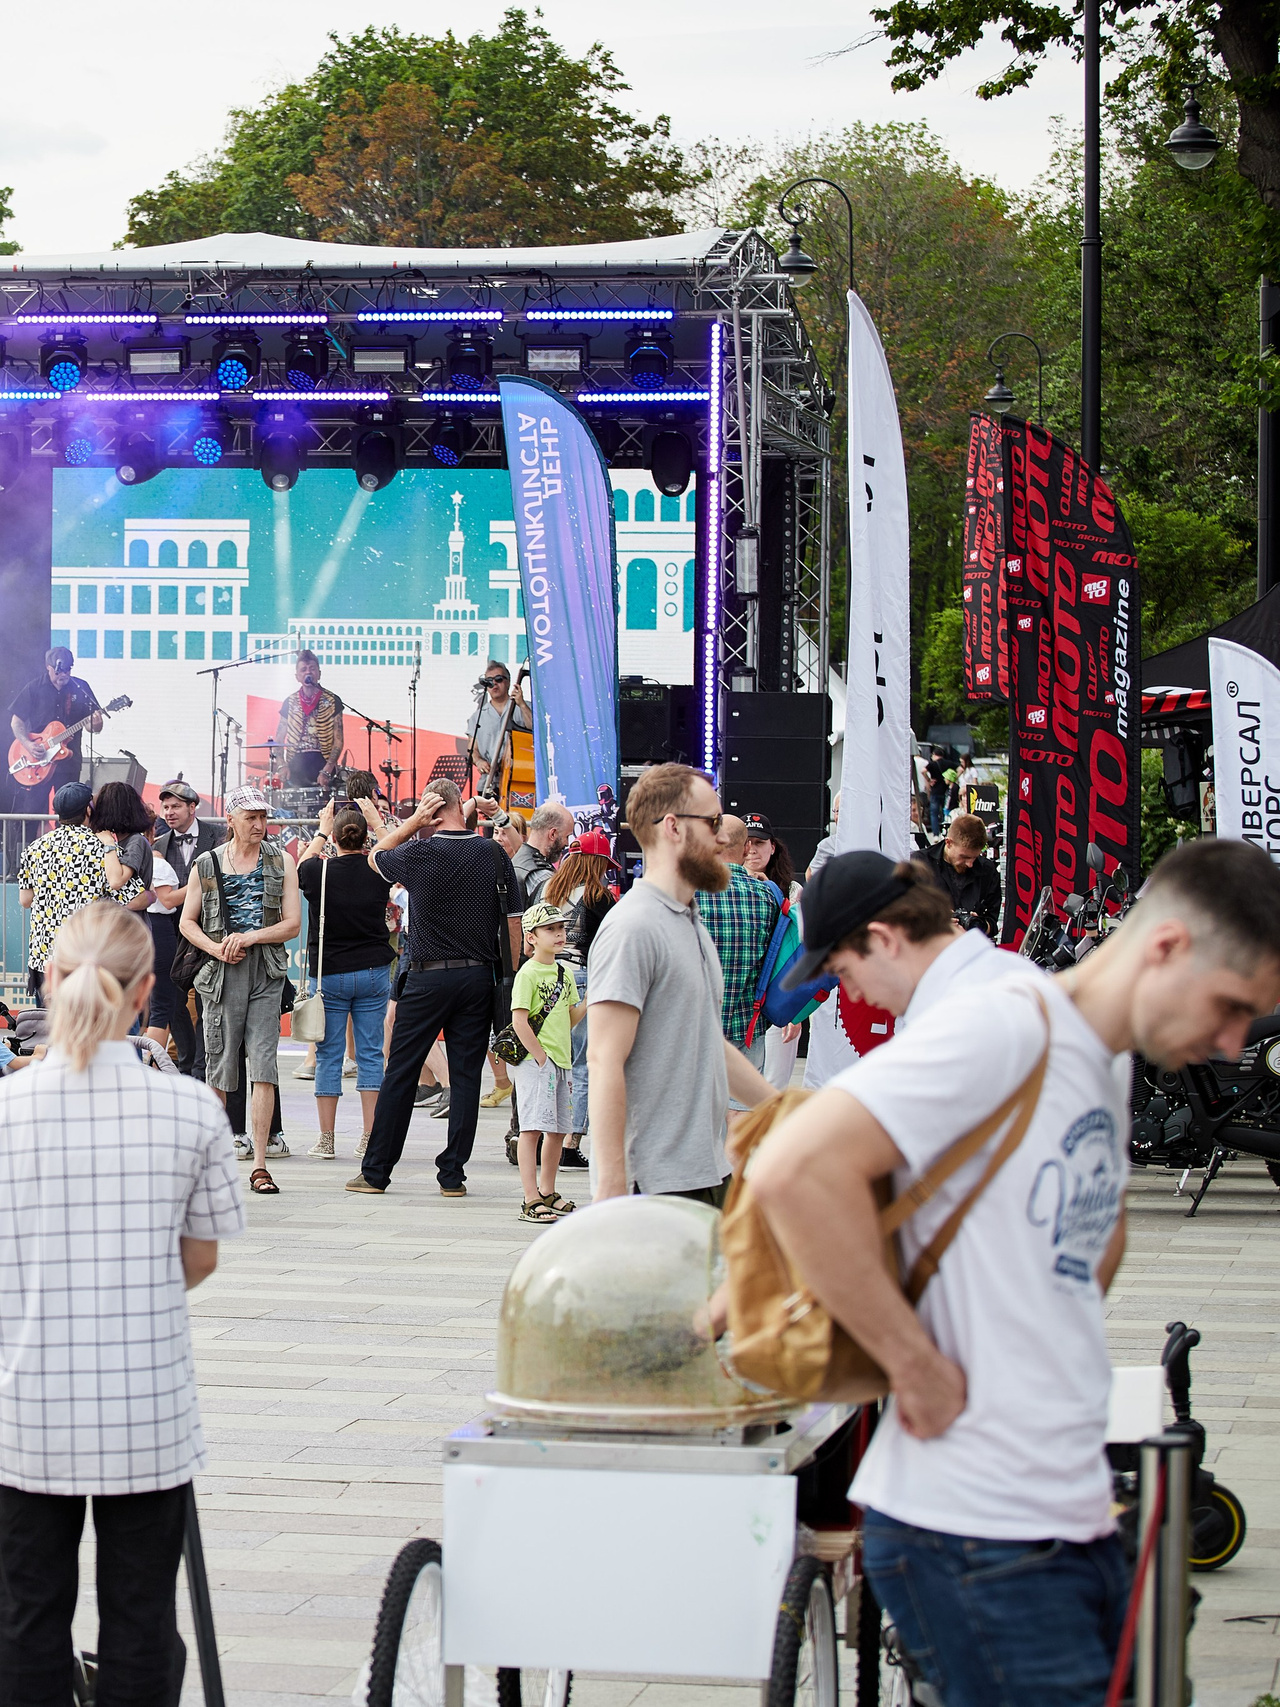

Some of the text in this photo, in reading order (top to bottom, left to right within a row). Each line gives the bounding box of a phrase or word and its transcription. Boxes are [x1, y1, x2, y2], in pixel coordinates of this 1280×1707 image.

[1011, 445, 1026, 549] MOTO
[1052, 520, 1087, 531] MOTO
[1077, 533, 1108, 543] MOTO
[981, 582, 991, 660] MOTO
[1038, 617, 1051, 706] MOTO
[1052, 551, 1081, 752] MOTO
[1099, 626, 1110, 683] MOTO
[1113, 579, 1131, 739] magazine
[1018, 730, 1044, 741] OTO
[1082, 709, 1111, 718] MOTO
[974, 799, 996, 812] thor
